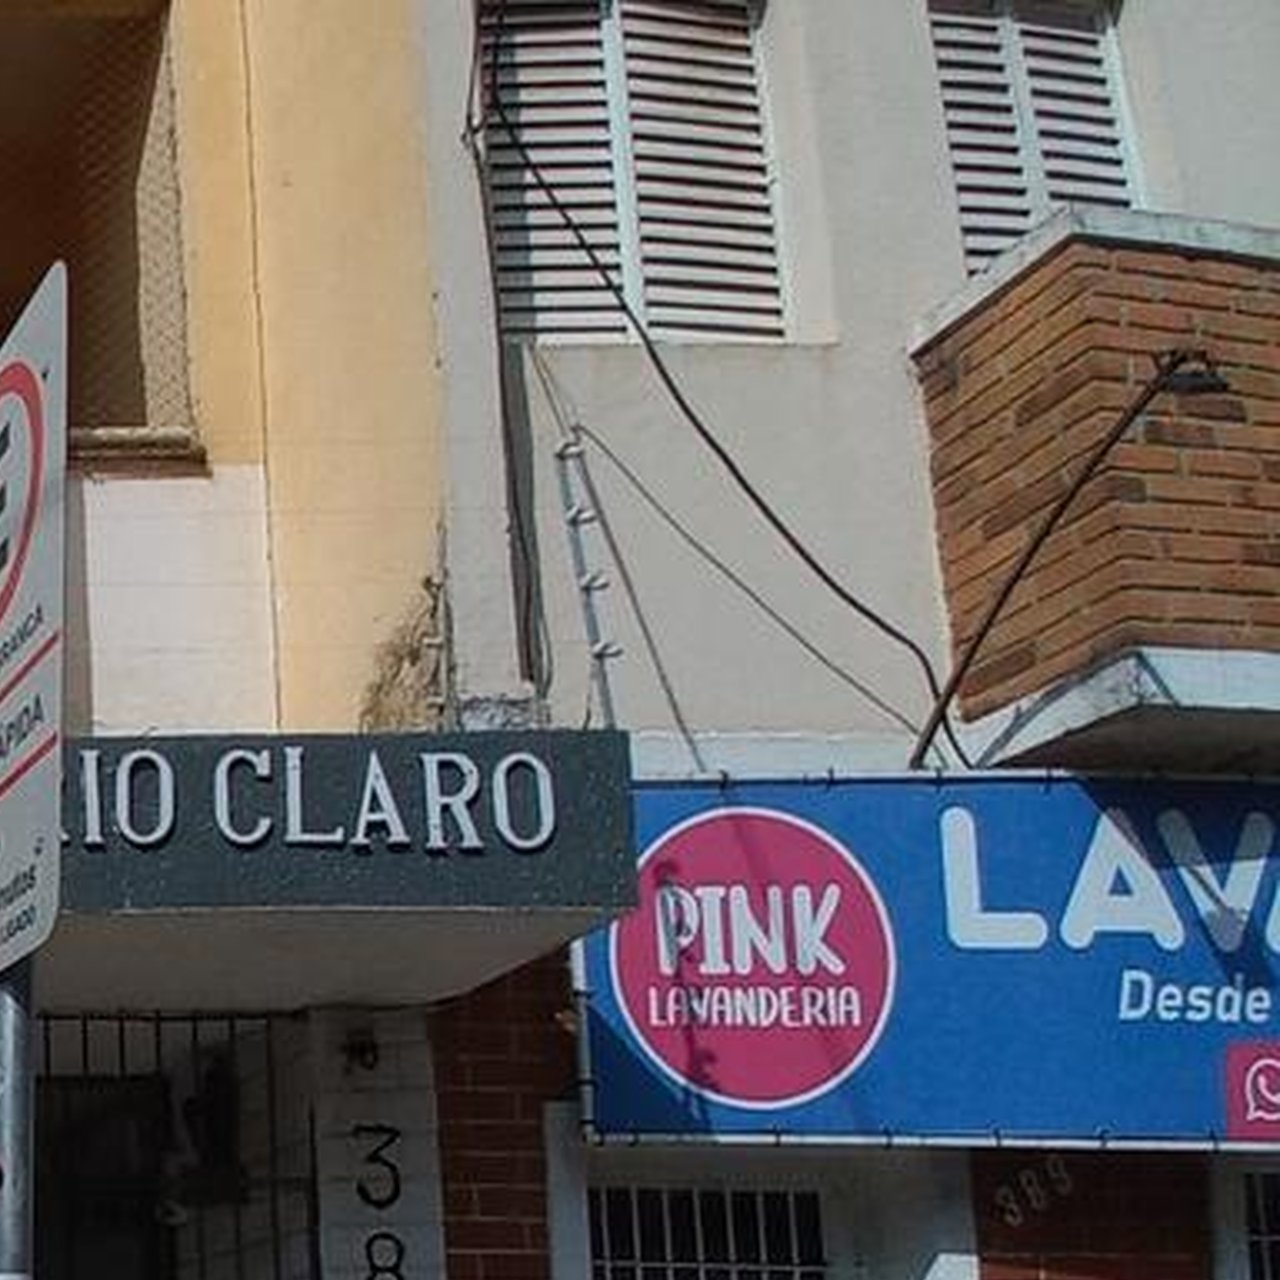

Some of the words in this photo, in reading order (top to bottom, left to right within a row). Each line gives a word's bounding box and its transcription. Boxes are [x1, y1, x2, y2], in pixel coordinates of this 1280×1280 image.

[214, 746, 558, 851] CLARO
[941, 805, 1280, 952] LAV
[655, 883, 847, 977] PINK
[648, 984, 861, 1028] LAVANDERIA
[1117, 966, 1272, 1023] Desde
